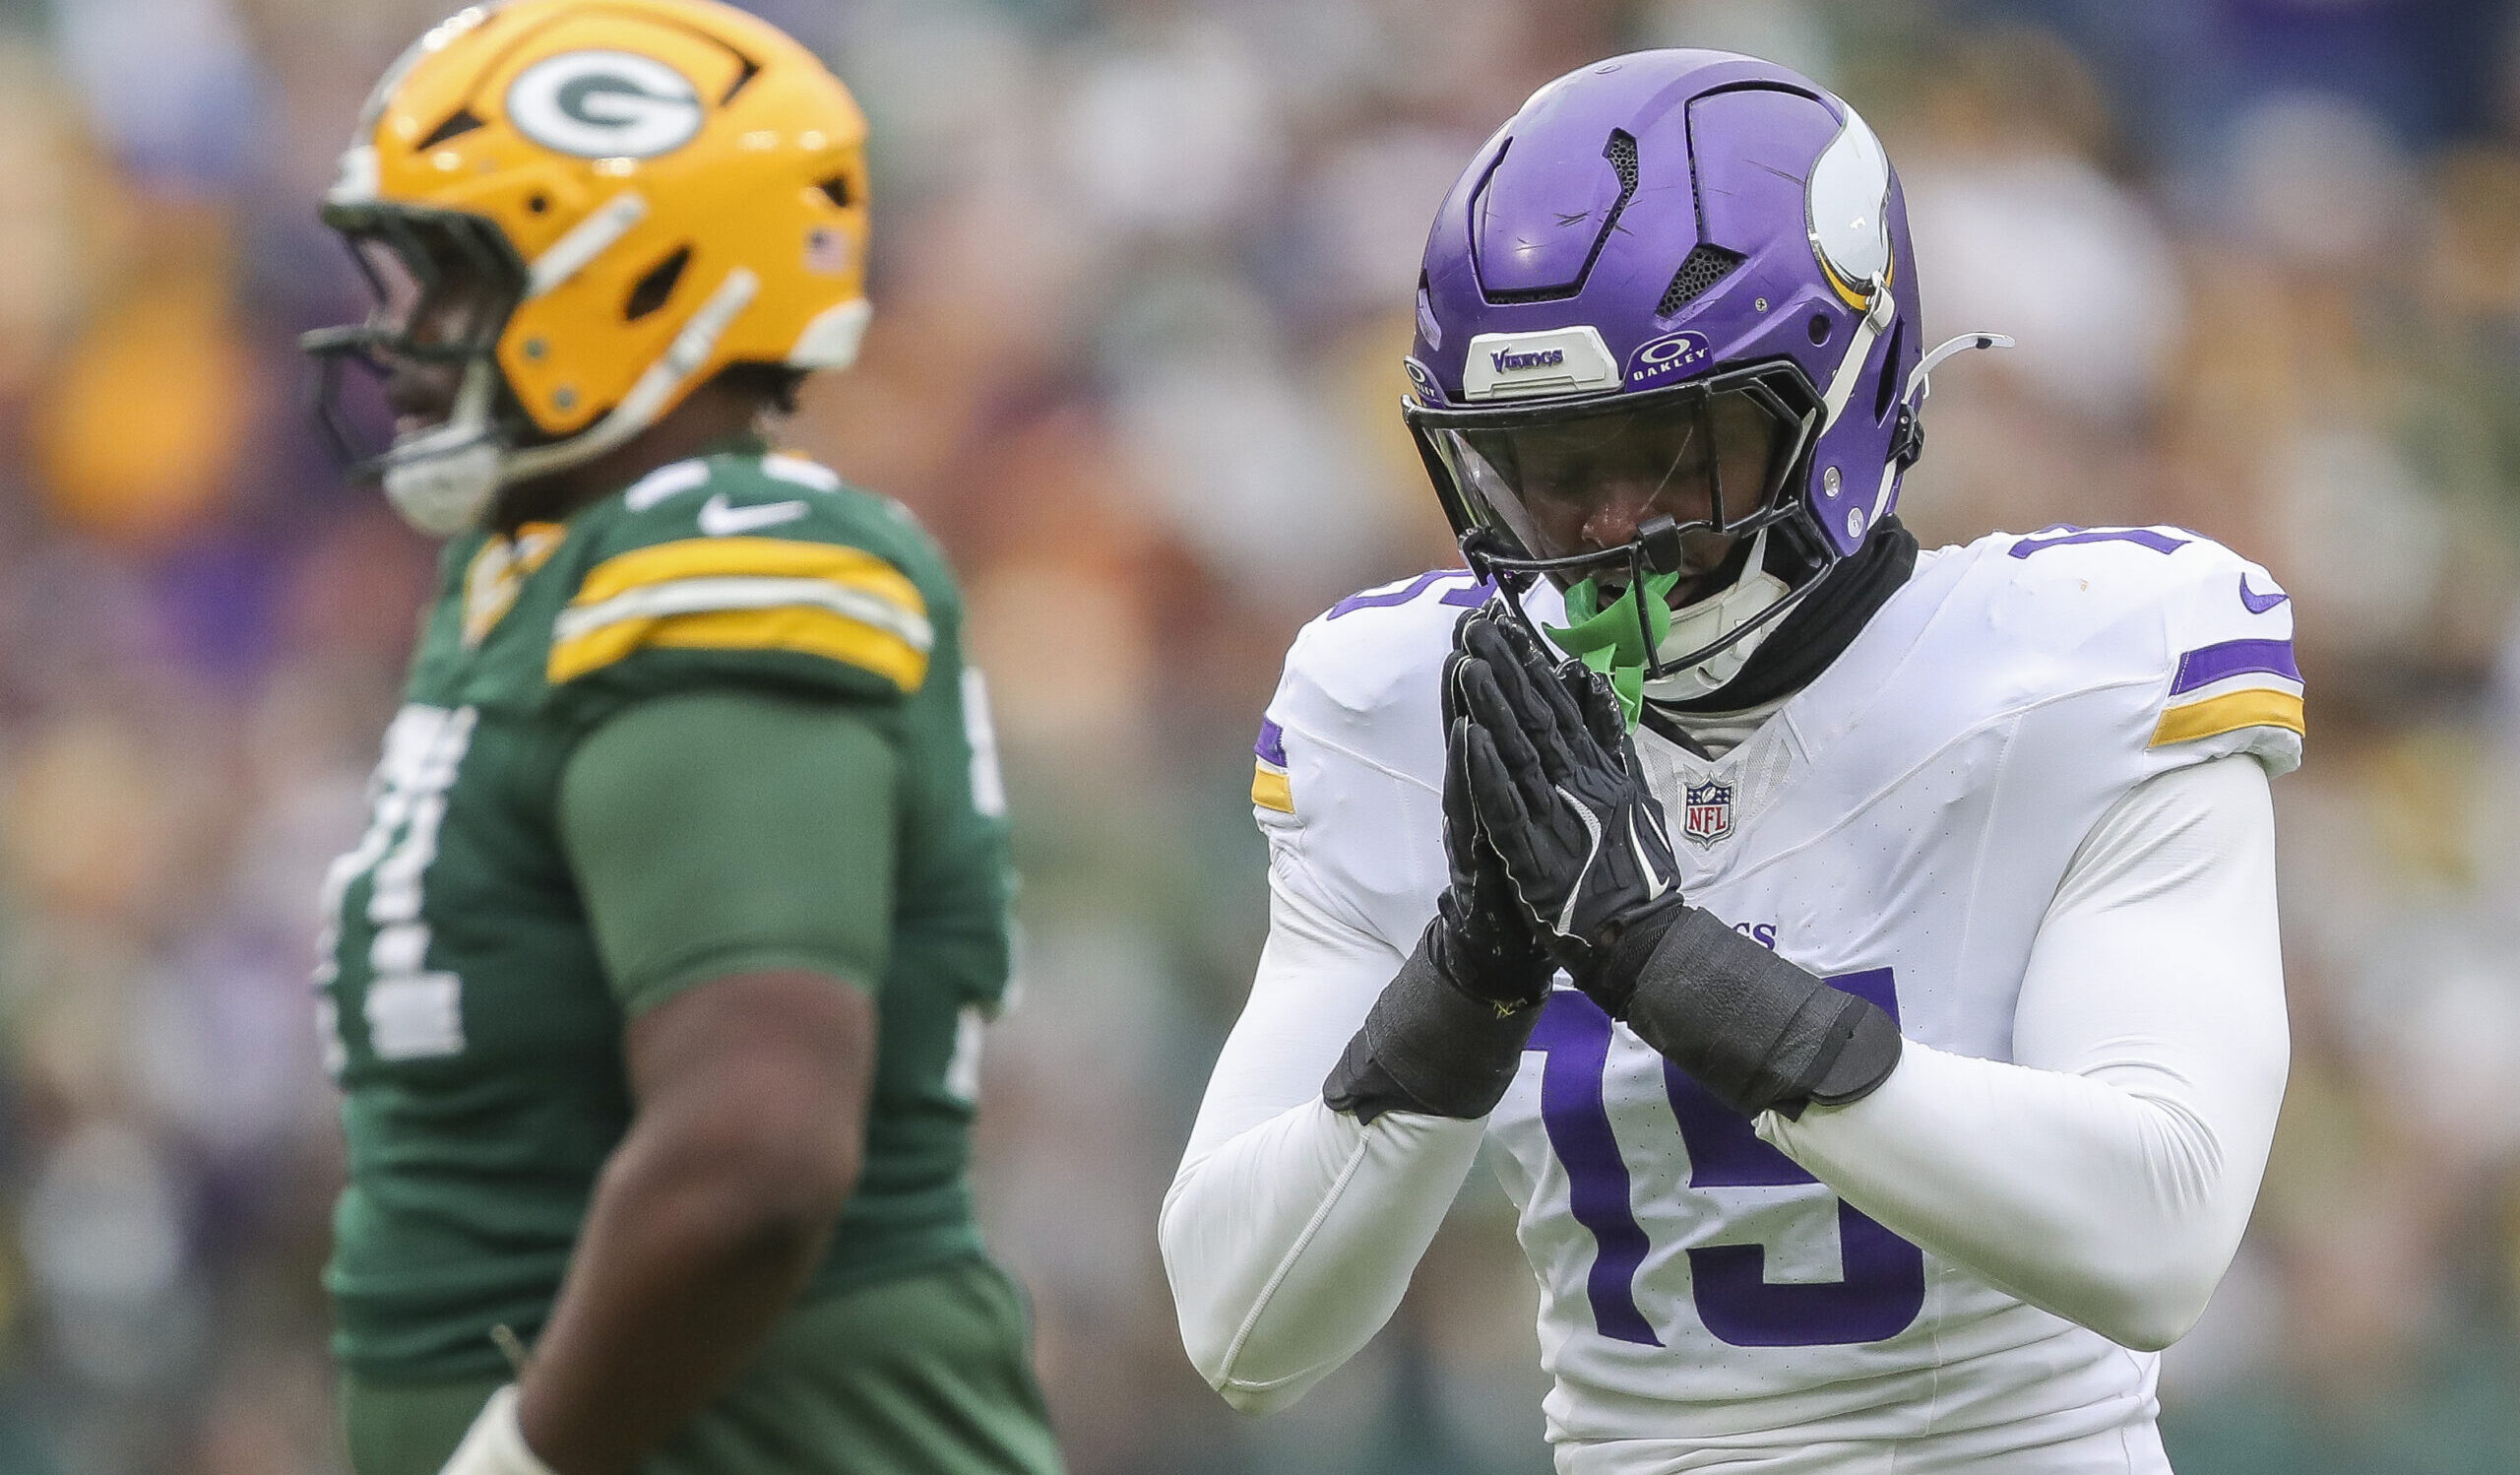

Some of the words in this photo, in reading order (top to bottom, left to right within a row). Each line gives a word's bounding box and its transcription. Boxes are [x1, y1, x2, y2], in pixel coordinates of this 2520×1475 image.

[1633, 349, 1706, 381] OAKLEY
[1688, 806, 1727, 835] NFL
[1521, 965, 1926, 1349] 15
